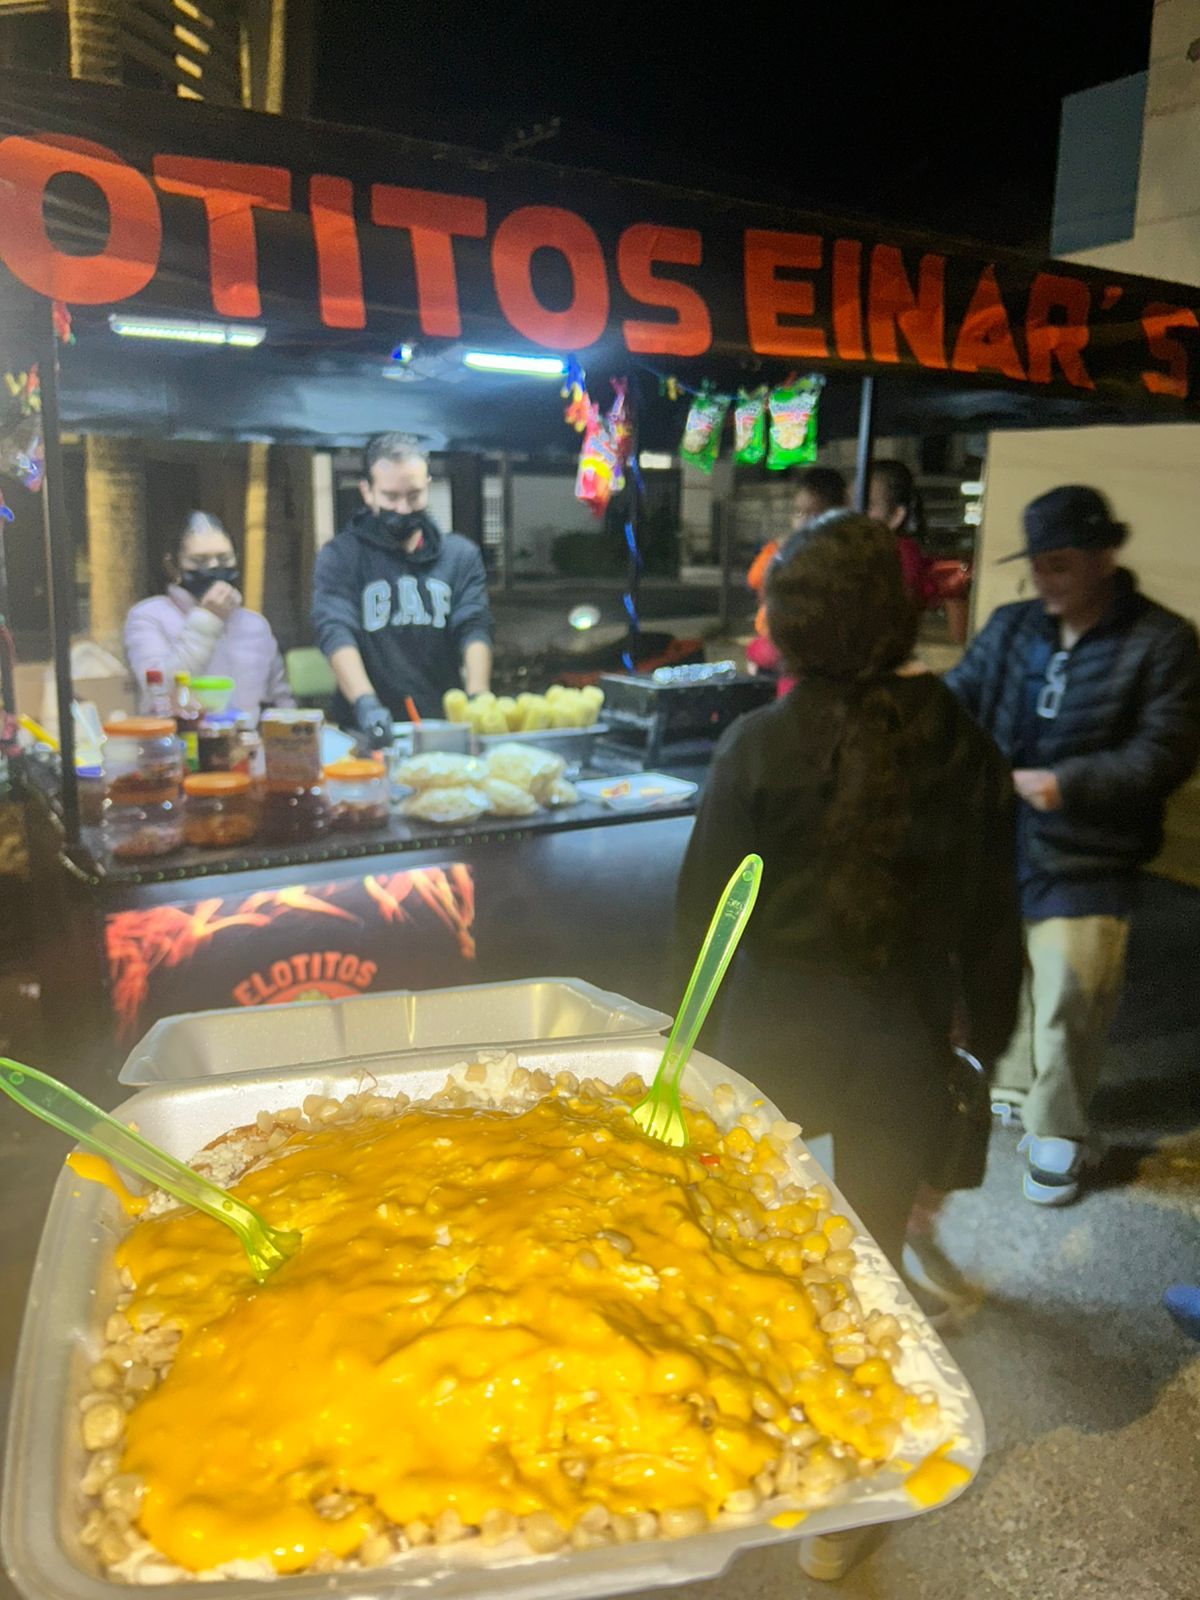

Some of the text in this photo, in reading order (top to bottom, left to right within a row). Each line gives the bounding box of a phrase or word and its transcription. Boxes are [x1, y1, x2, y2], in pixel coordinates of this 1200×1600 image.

[0, 132, 1199, 398] OTITOS EINAR'S
[232, 951, 378, 1006] ELOTITOS
